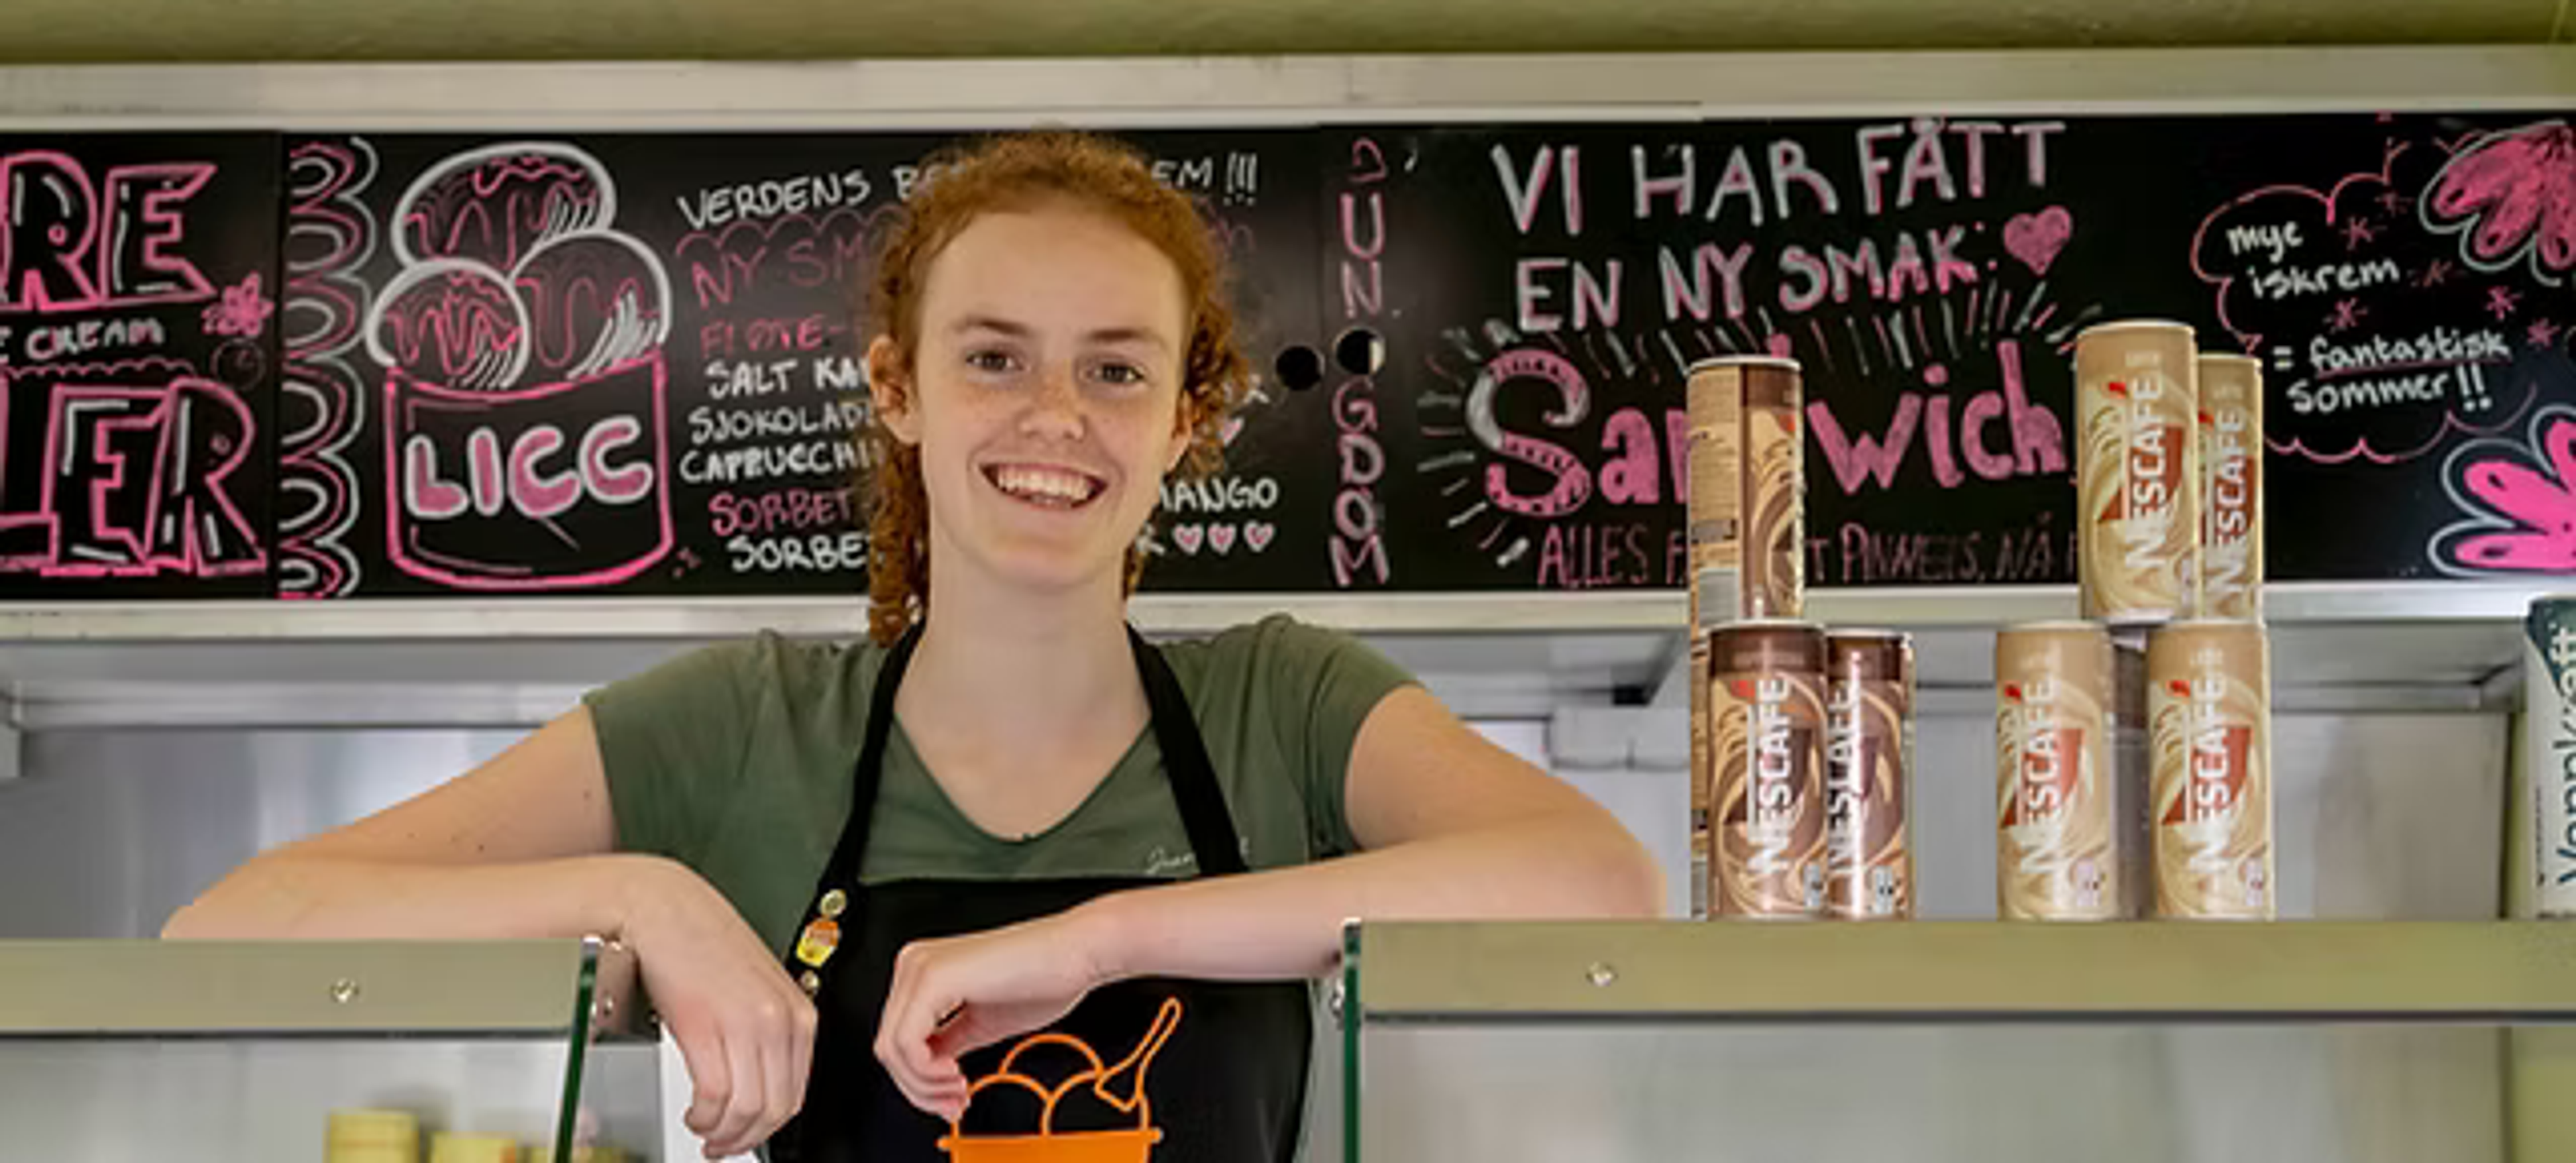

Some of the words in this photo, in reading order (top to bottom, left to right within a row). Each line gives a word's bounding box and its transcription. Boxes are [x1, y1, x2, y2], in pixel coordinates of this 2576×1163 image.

[677, 169, 871, 230] VERDENS
[1490, 144, 1581, 235] VI
[1631, 140, 1838, 225] HAR
[1858, 117, 2066, 215] FÅTT
[692, 244, 767, 309] NY
[786, 231, 865, 287] SM
[2226, 221, 2303, 264] mye
[1515, 258, 1622, 331] EN
[1659, 242, 1752, 321] NY
[2247, 258, 2400, 300] iskrem
[25, 317, 164, 360] CREAM
[2309, 325, 2511, 368] fantastisk
[705, 359, 799, 399] SALT
[813, 356, 871, 390] KA
[1466, 333, 2067, 517] Sawich
[405, 415, 654, 518] LICC
[708, 487, 853, 536] SORBET
[727, 531, 871, 573] SORBE
[1537, 522, 1648, 588] ALLES
